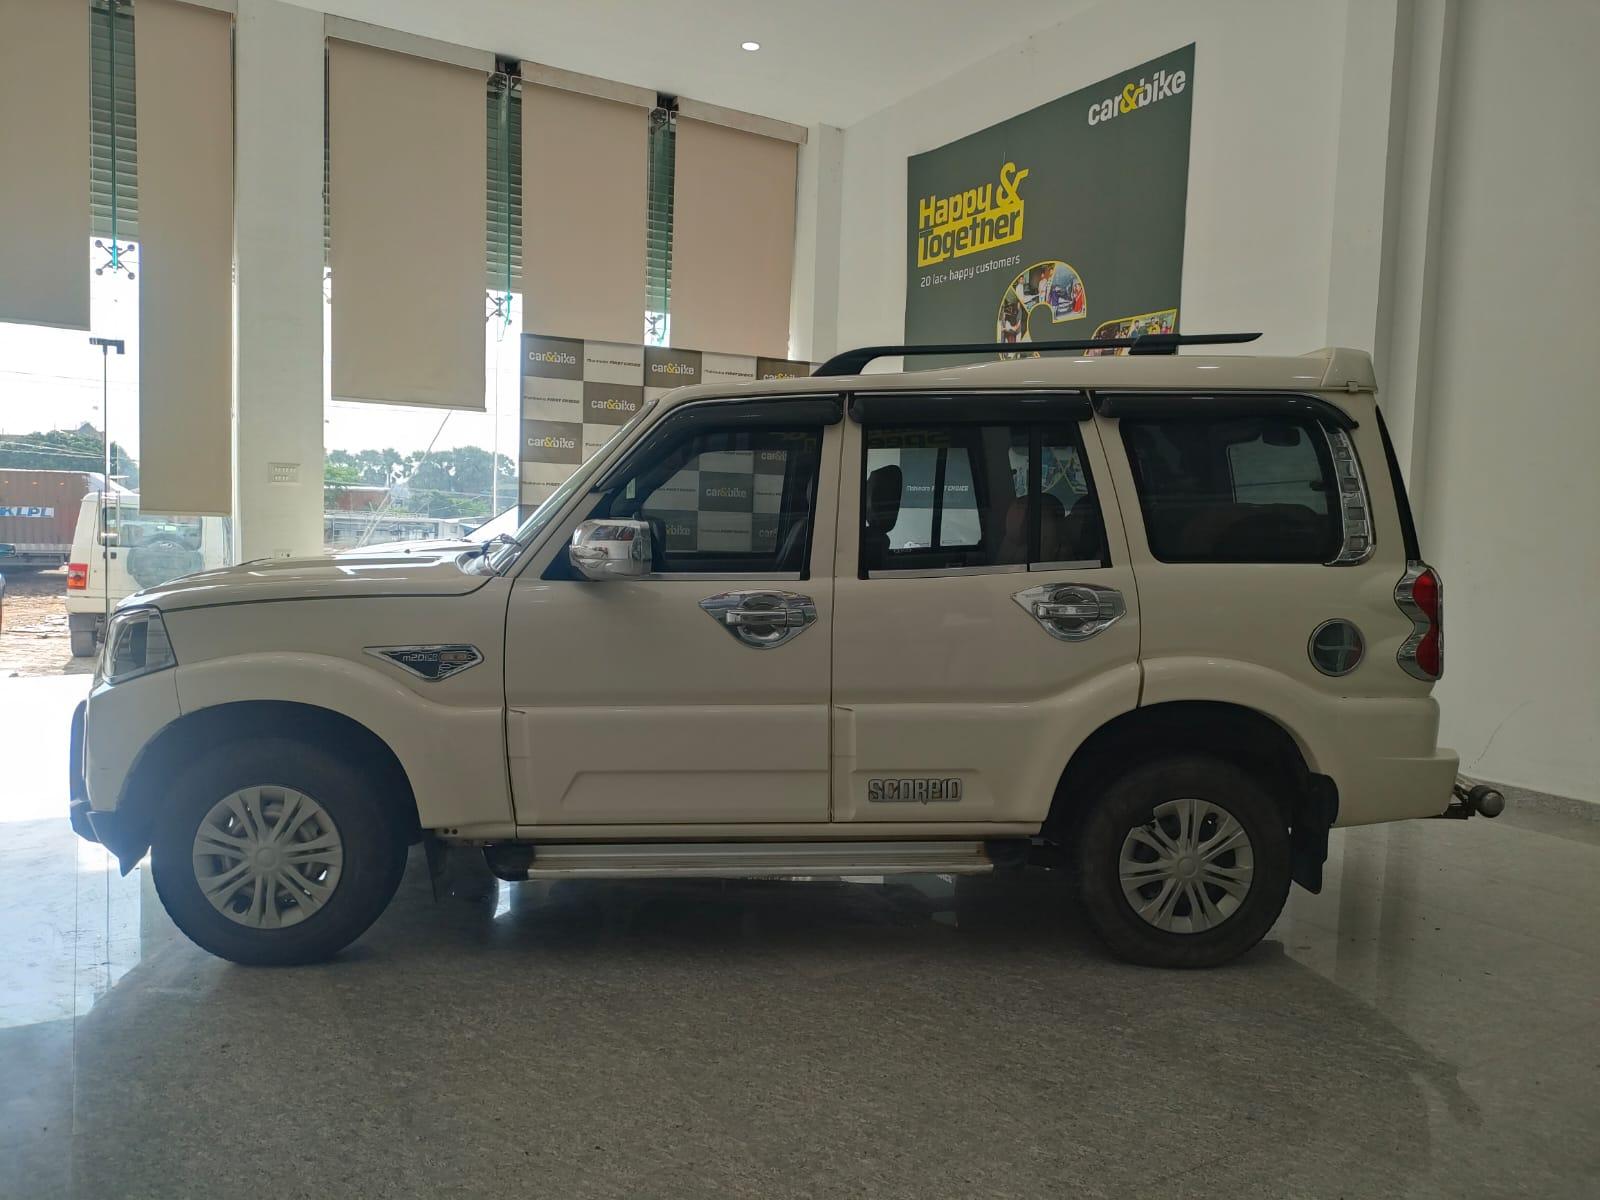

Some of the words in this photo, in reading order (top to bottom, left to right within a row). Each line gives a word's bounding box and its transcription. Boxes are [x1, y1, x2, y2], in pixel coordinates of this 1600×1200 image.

[1087, 70, 1186, 126] car&bike
[919, 183, 993, 229] Happy
[995, 161, 1029, 208] &
[919, 210, 1021, 261] Together
[920, 276, 932, 288] 20
[949, 266, 975, 281] happy
[976, 255, 1021, 275] customers
[528, 351, 576, 365] car&bike
[651, 363, 695, 375] car&bike
[591, 399, 636, 412] car&bike
[527, 436, 575, 449] car&bike
[705, 487, 747, 499] car&bike
[868, 779, 961, 804] SCORPIO
